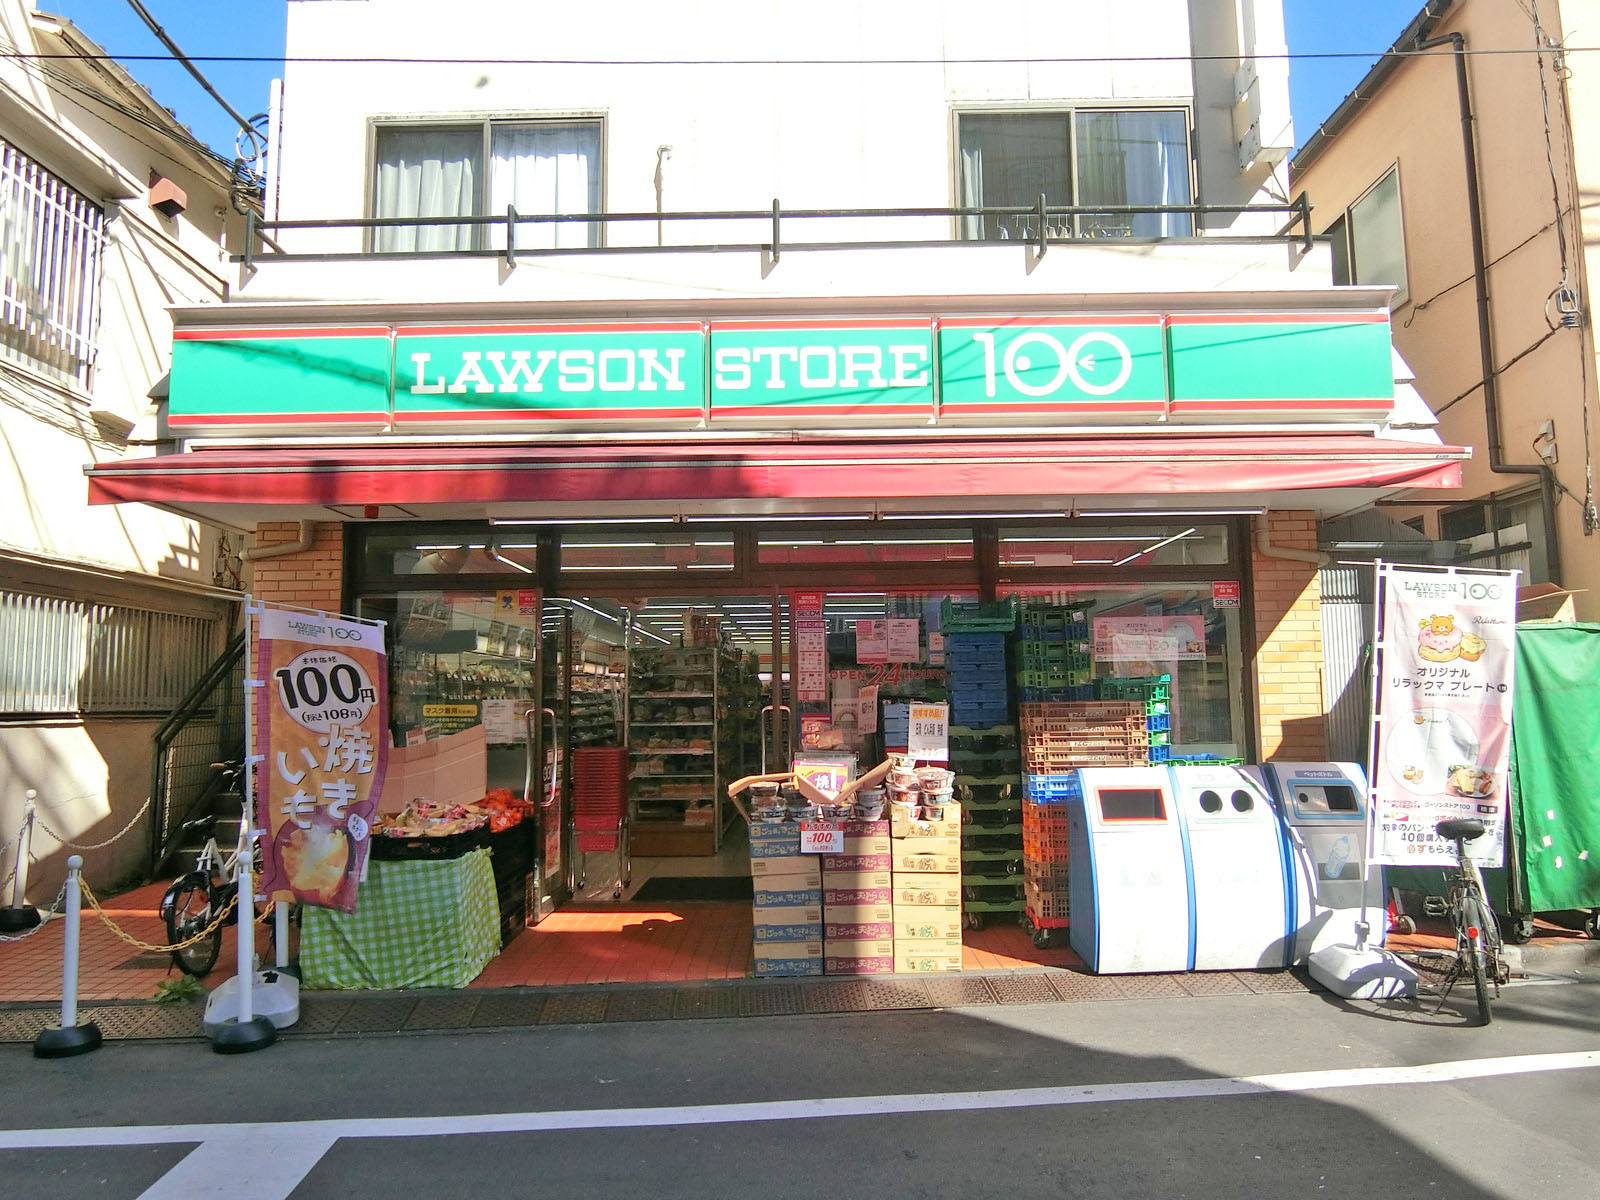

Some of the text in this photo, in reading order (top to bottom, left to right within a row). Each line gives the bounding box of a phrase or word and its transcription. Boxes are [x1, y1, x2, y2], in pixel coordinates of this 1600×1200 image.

[411, 331, 1132, 398] LAWSON STORE 100
[1404, 581, 1502, 600] LAWSON 100
[328, 626, 362, 641] 100
[829, 670, 866, 680] OPEN
[867, 663, 902, 687] 24
[1416, 667, 1471, 678] オリジナル
[1393, 678, 1495, 693] リラックマ プレート
